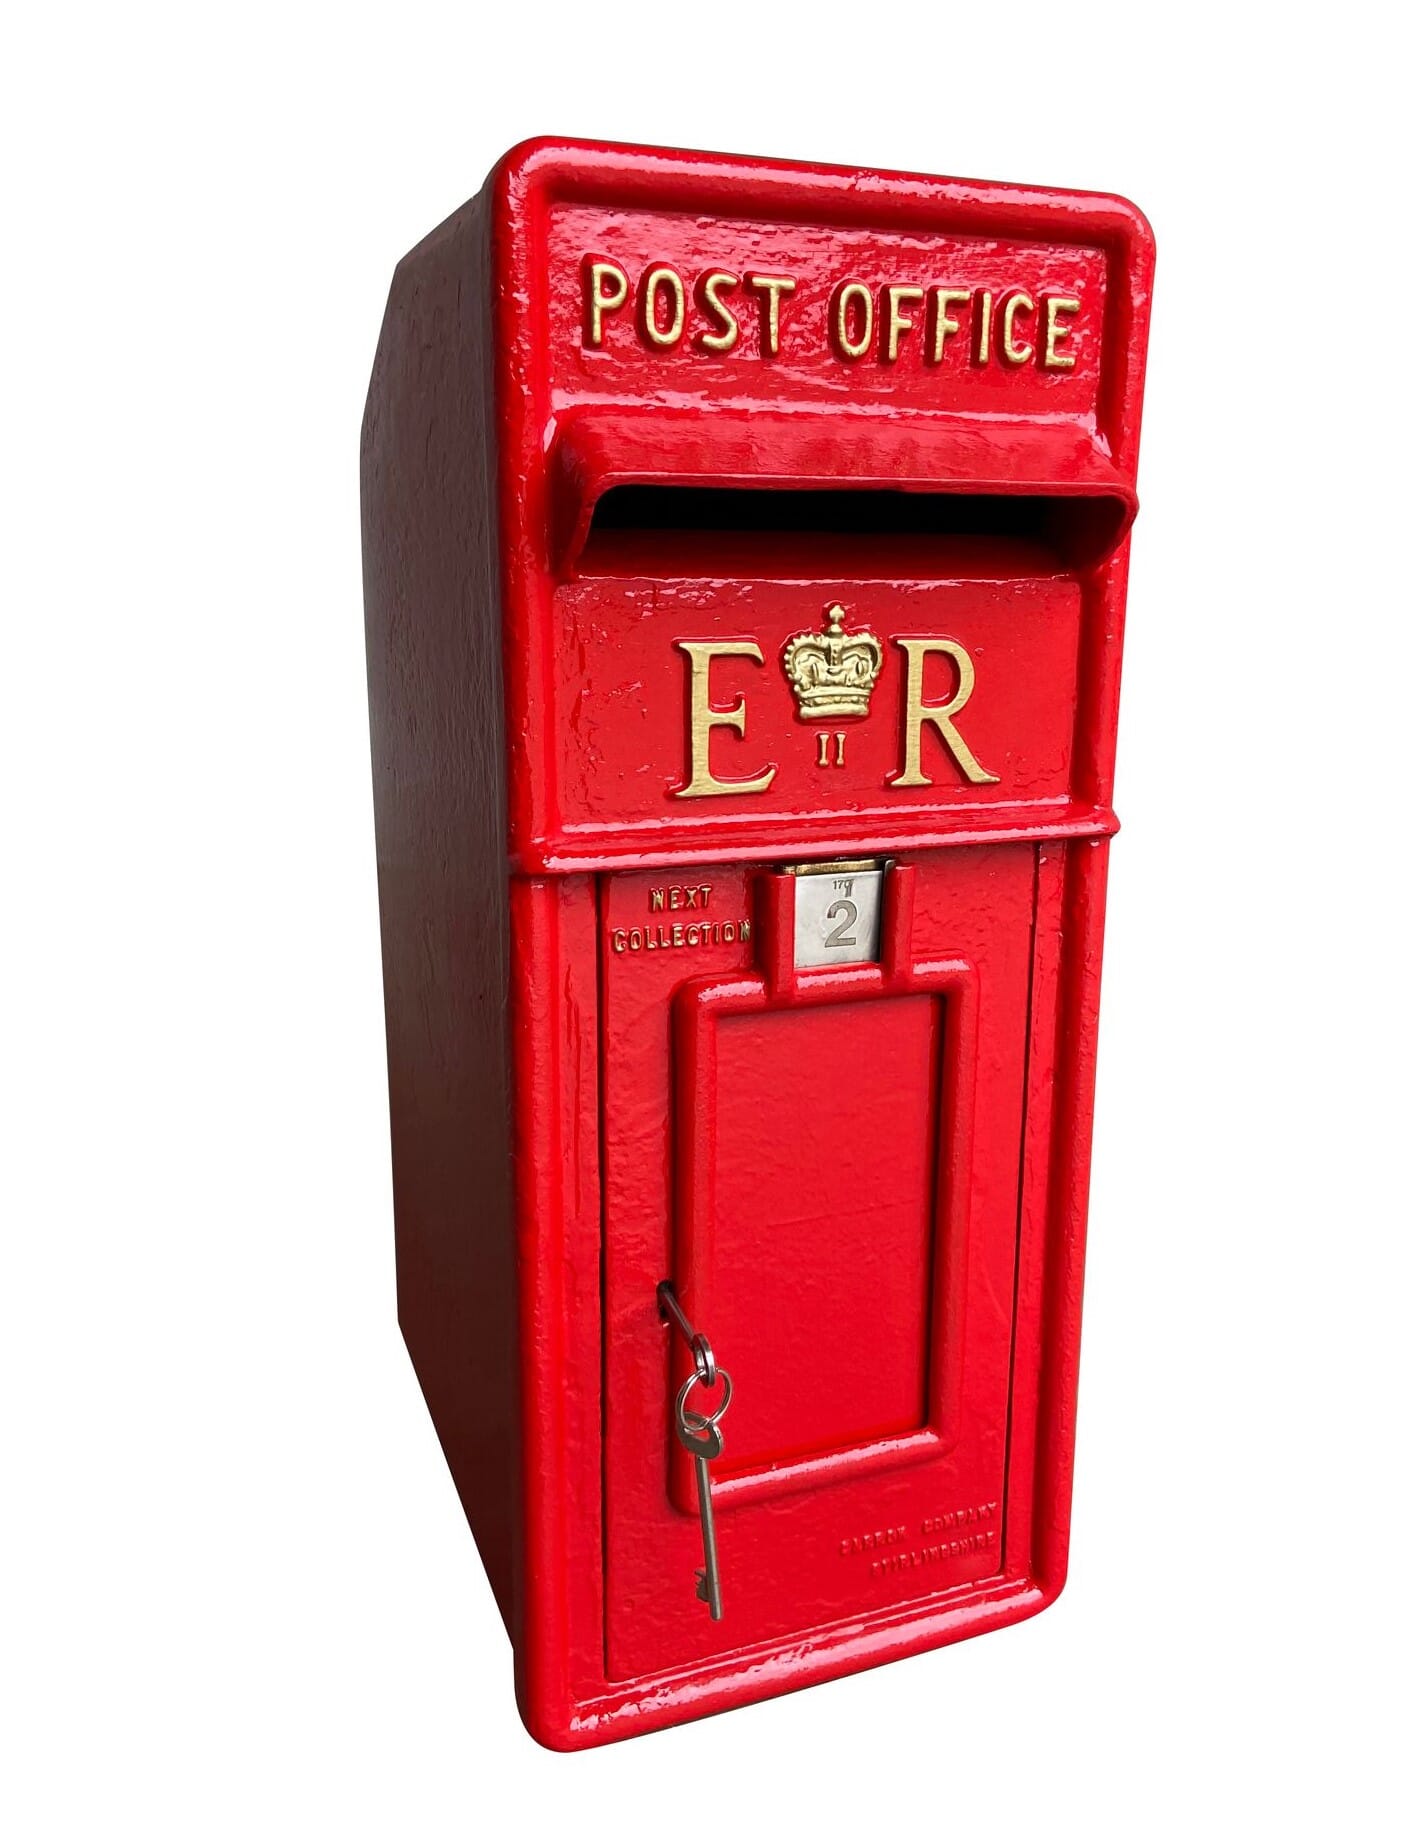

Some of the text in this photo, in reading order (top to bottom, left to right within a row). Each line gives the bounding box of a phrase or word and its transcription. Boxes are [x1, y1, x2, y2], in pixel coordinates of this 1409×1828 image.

[591, 263, 1081, 367] POST OFFICE
[675, 639, 1001, 797] E R
[651, 885, 712, 912] NEXT
[613, 919, 751, 952] COLLECTION
[824, 899, 858, 948] 2
[921, 1501, 998, 1535] COMPANY
